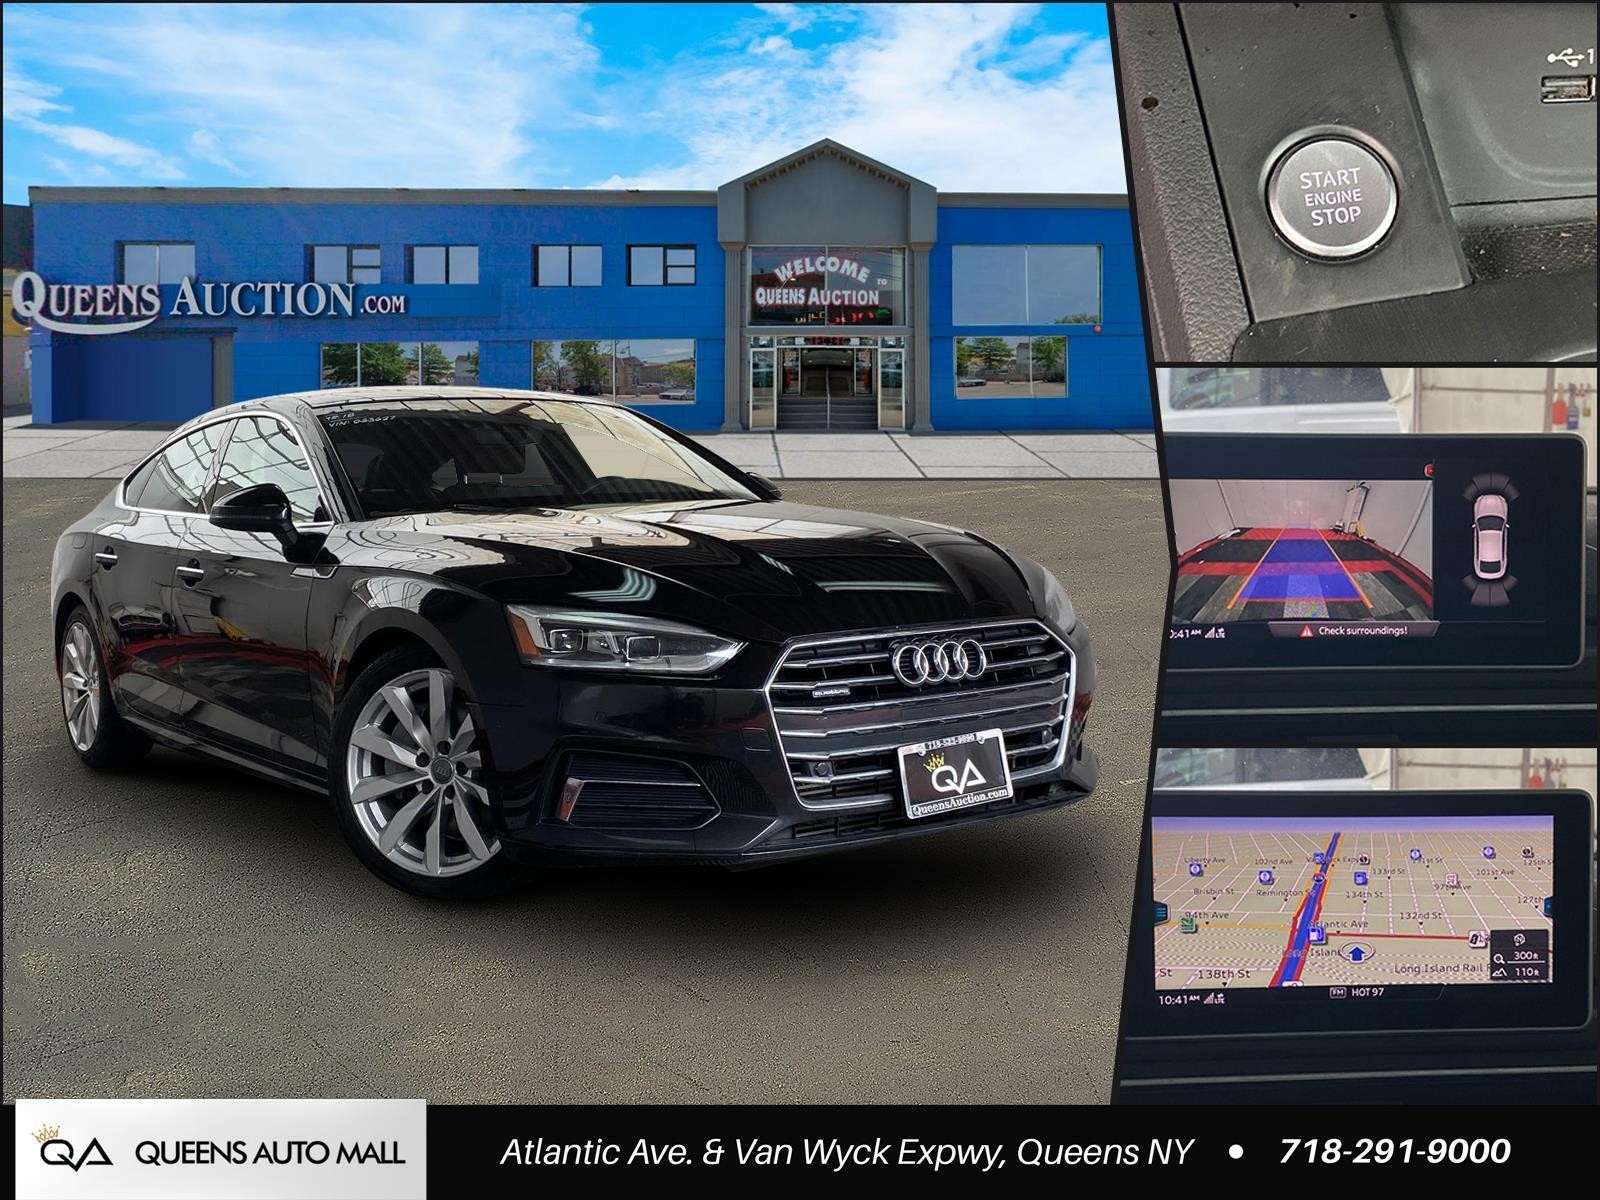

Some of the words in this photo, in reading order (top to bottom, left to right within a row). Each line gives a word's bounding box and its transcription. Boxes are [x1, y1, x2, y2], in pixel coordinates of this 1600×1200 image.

[1300, 167, 1361, 190] START
[1304, 189, 1362, 206] ENGINE
[1311, 206, 1361, 227] STOP
[774, 255, 871, 283] WELCOME
[755, 286, 806, 306] QUEENS
[808, 287, 880, 306] AUCTION
[11, 270, 161, 335] QUEENS
[1319, 626, 1345, 636] Check
[1346, 626, 1408, 637] surroundings!
[912, 787, 1008, 816] QueensAuction.com
[1257, 889, 1303, 898] Remington
[1211, 911, 1230, 919] Ave
[1400, 911, 1430, 920] 132nd
[1431, 911, 1442, 919] St
[1350, 919, 1369, 928] Ave
[1159, 968, 1173, 977] St
[1198, 969, 1235, 979] 138th
[1237, 969, 1251, 978] St
[1395, 963, 1422, 974] Long
[1425, 963, 1460, 973] Island
[1462, 963, 1484, 972] Rail
[1351, 987, 1370, 997] HOT
[1372, 987, 1385, 996] 97
